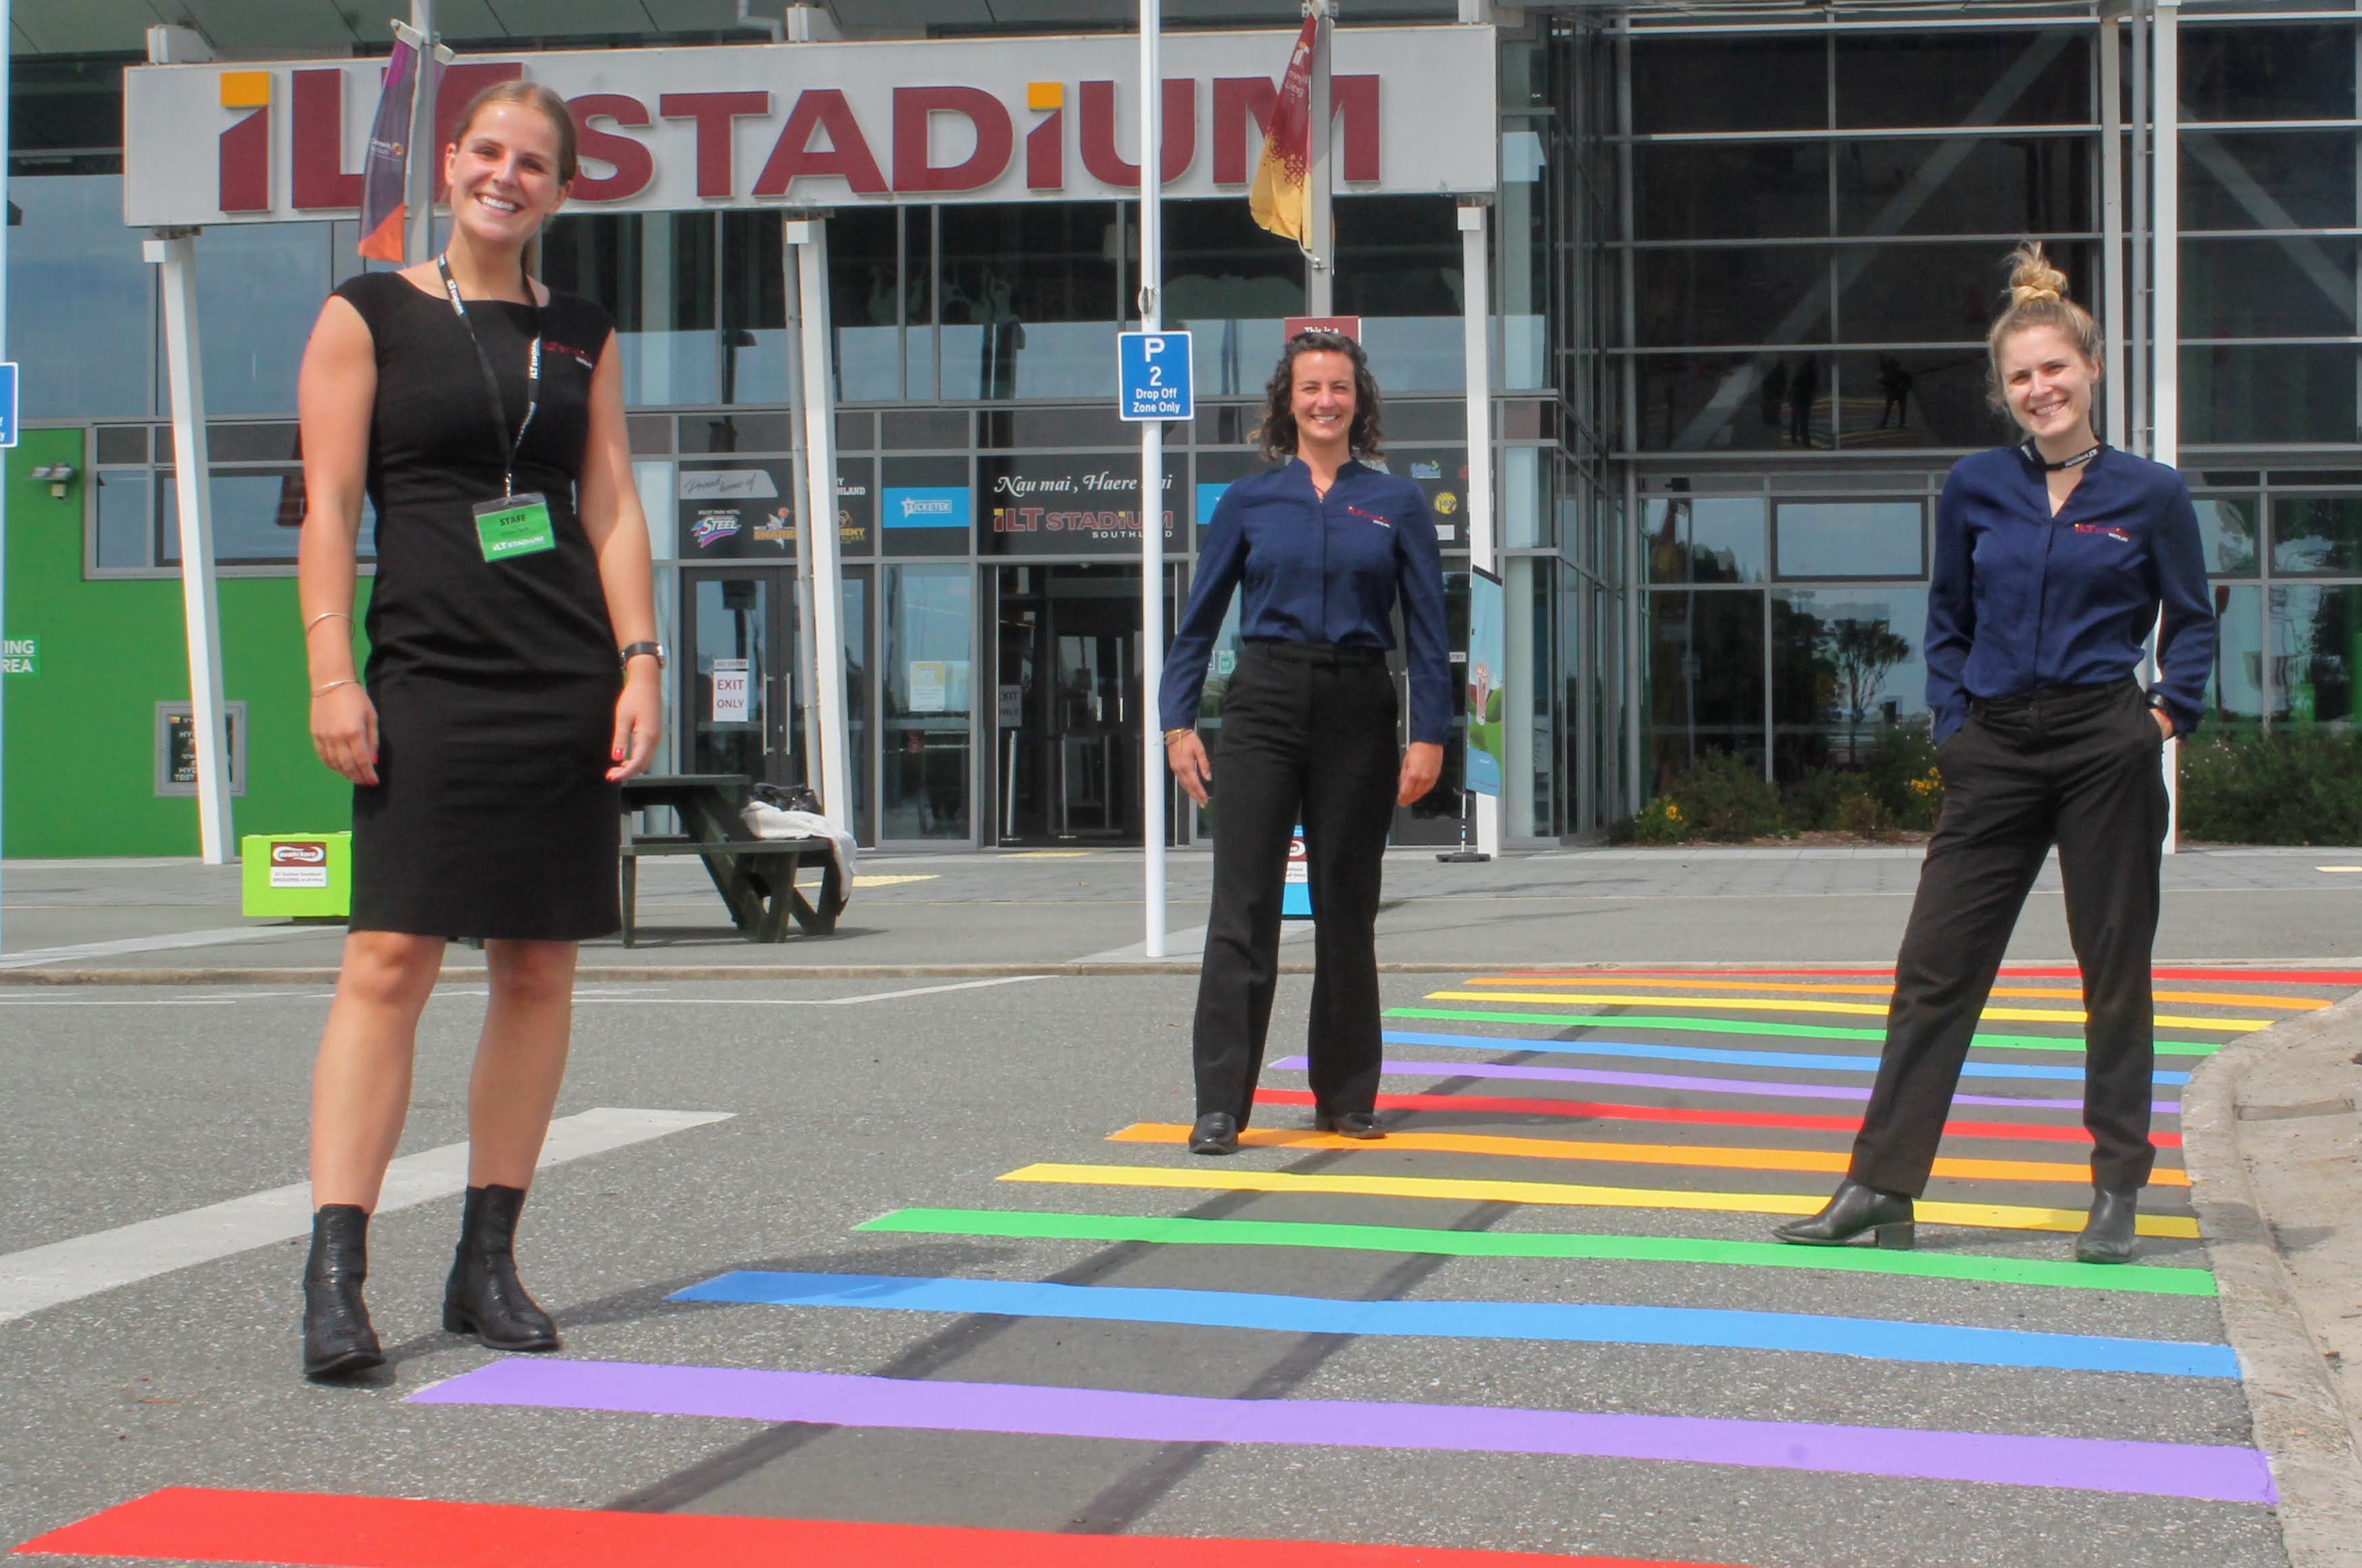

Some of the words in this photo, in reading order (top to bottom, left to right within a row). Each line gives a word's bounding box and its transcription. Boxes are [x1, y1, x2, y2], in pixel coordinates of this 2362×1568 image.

[1144, 337, 1165, 362] P
[1150, 366, 1162, 387] 2
[1135, 389, 1159, 401] Drop
[1161, 387, 1177, 399] Off
[1133, 401, 1157, 413] Zone
[1158, 401, 1180, 414] Only
[994, 476, 1036, 497] Nau
[1083, 471, 1137, 491] Haere
[837, 487, 866, 495] HLAND
[903, 499, 952, 515] TICKETEK
[499, 514, 527, 526] STAFF
[699, 517, 737, 535] STEEL
[1092, 531, 1173, 539] SOUTHLD
[717, 679, 745, 690] EXIT
[716, 699, 745, 709] ONLY
